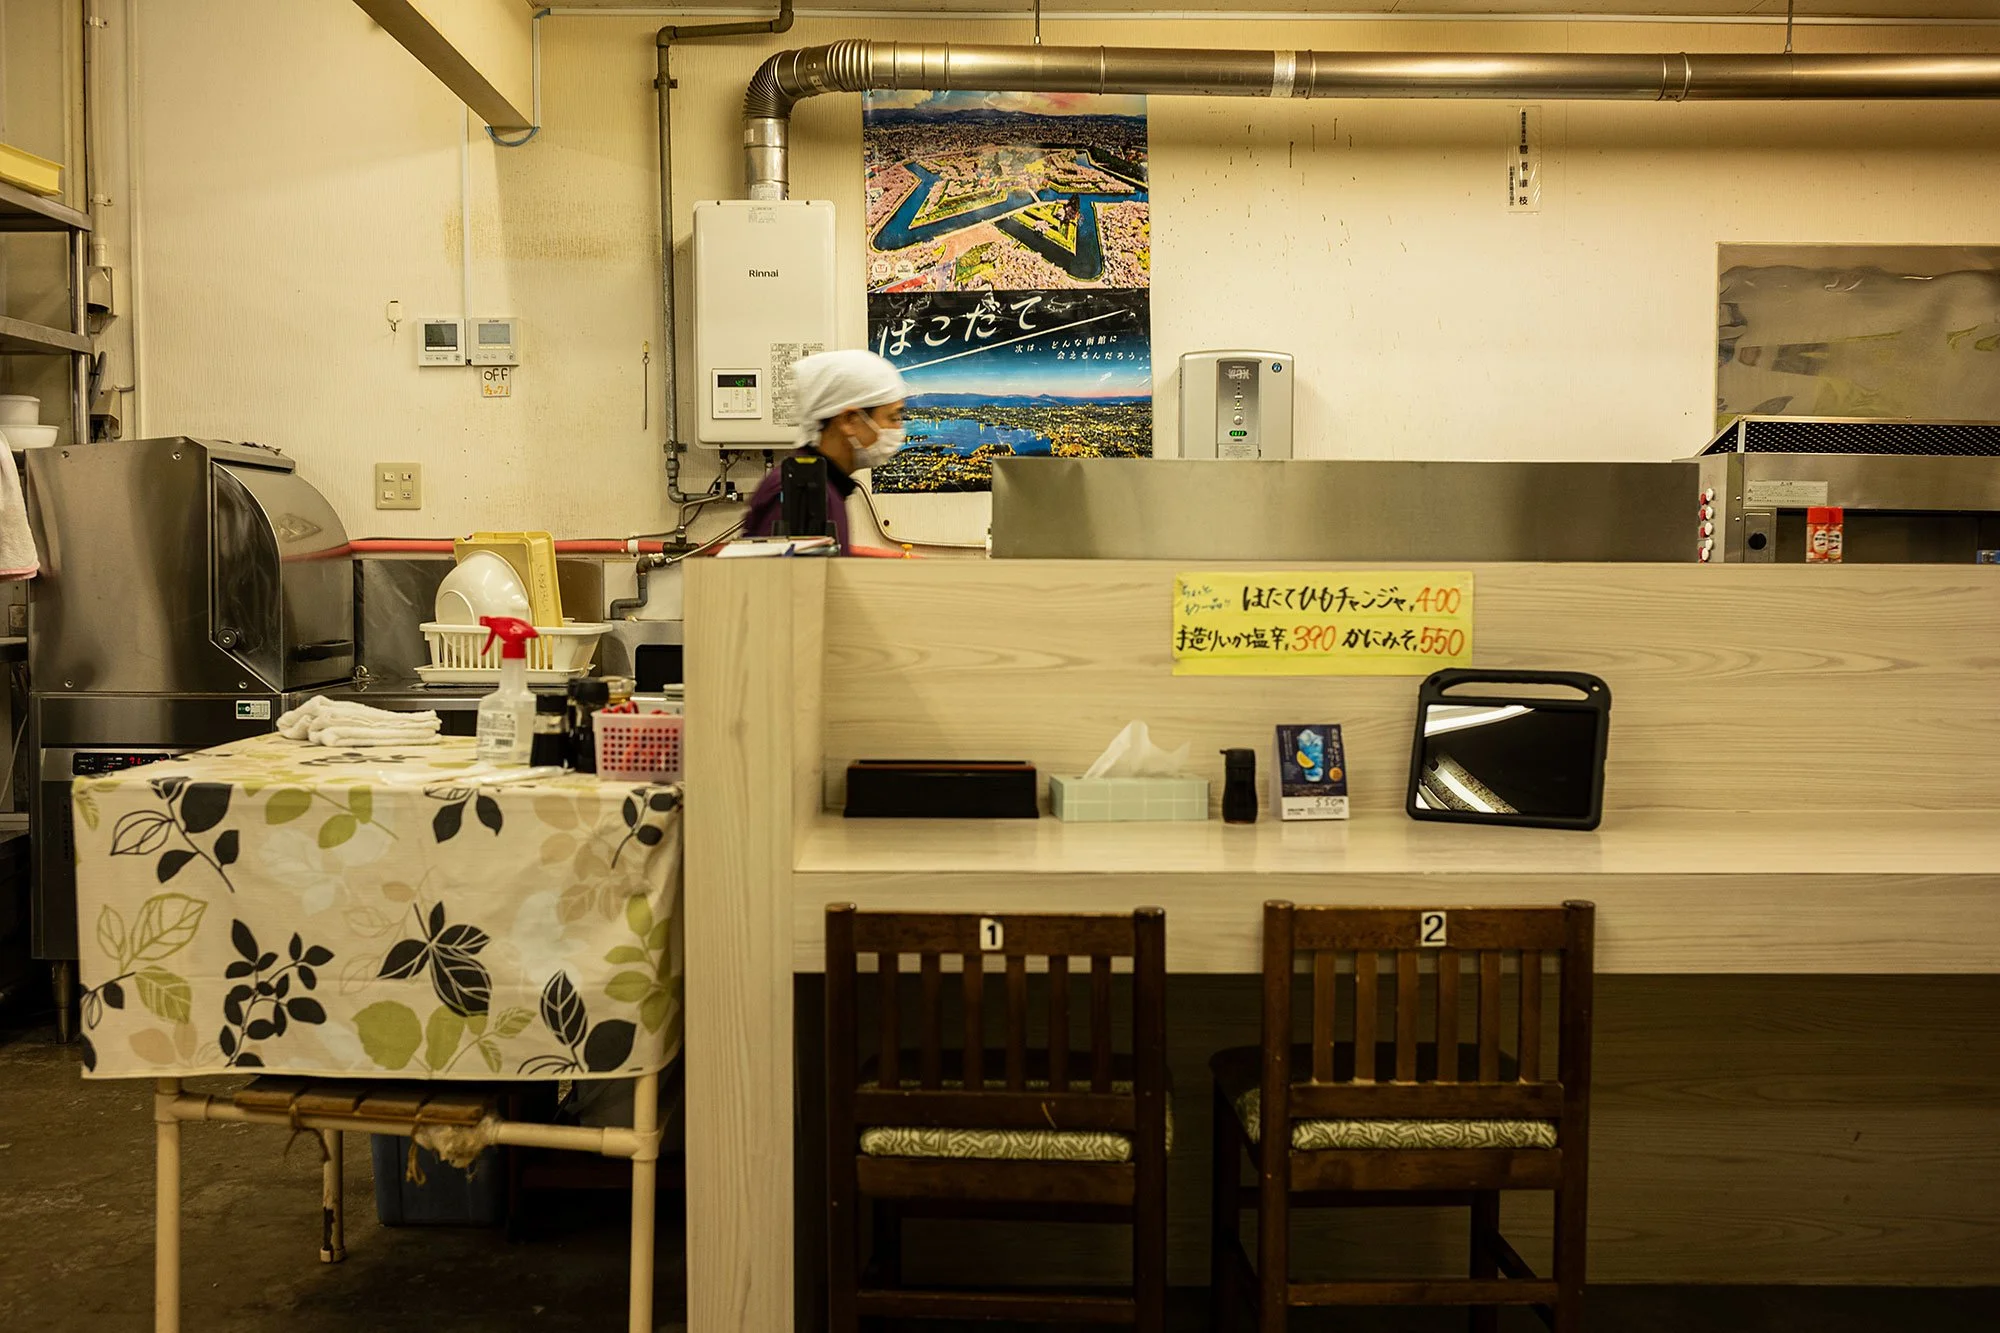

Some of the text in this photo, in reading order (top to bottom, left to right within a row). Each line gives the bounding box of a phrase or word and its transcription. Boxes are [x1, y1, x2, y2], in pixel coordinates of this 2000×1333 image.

[748, 269, 779, 278] Rinnai
[879, 295, 1042, 358] はこだて
[1057, 350, 1143, 361] 会えるんだろう。
[484, 367, 508, 382] OFF
[1416, 587, 1461, 614] 400
[1292, 625, 1336, 652] 390
[1420, 626, 1465, 657] 550
[987, 925, 996, 946] 1
[1424, 914, 1444, 943] 2
